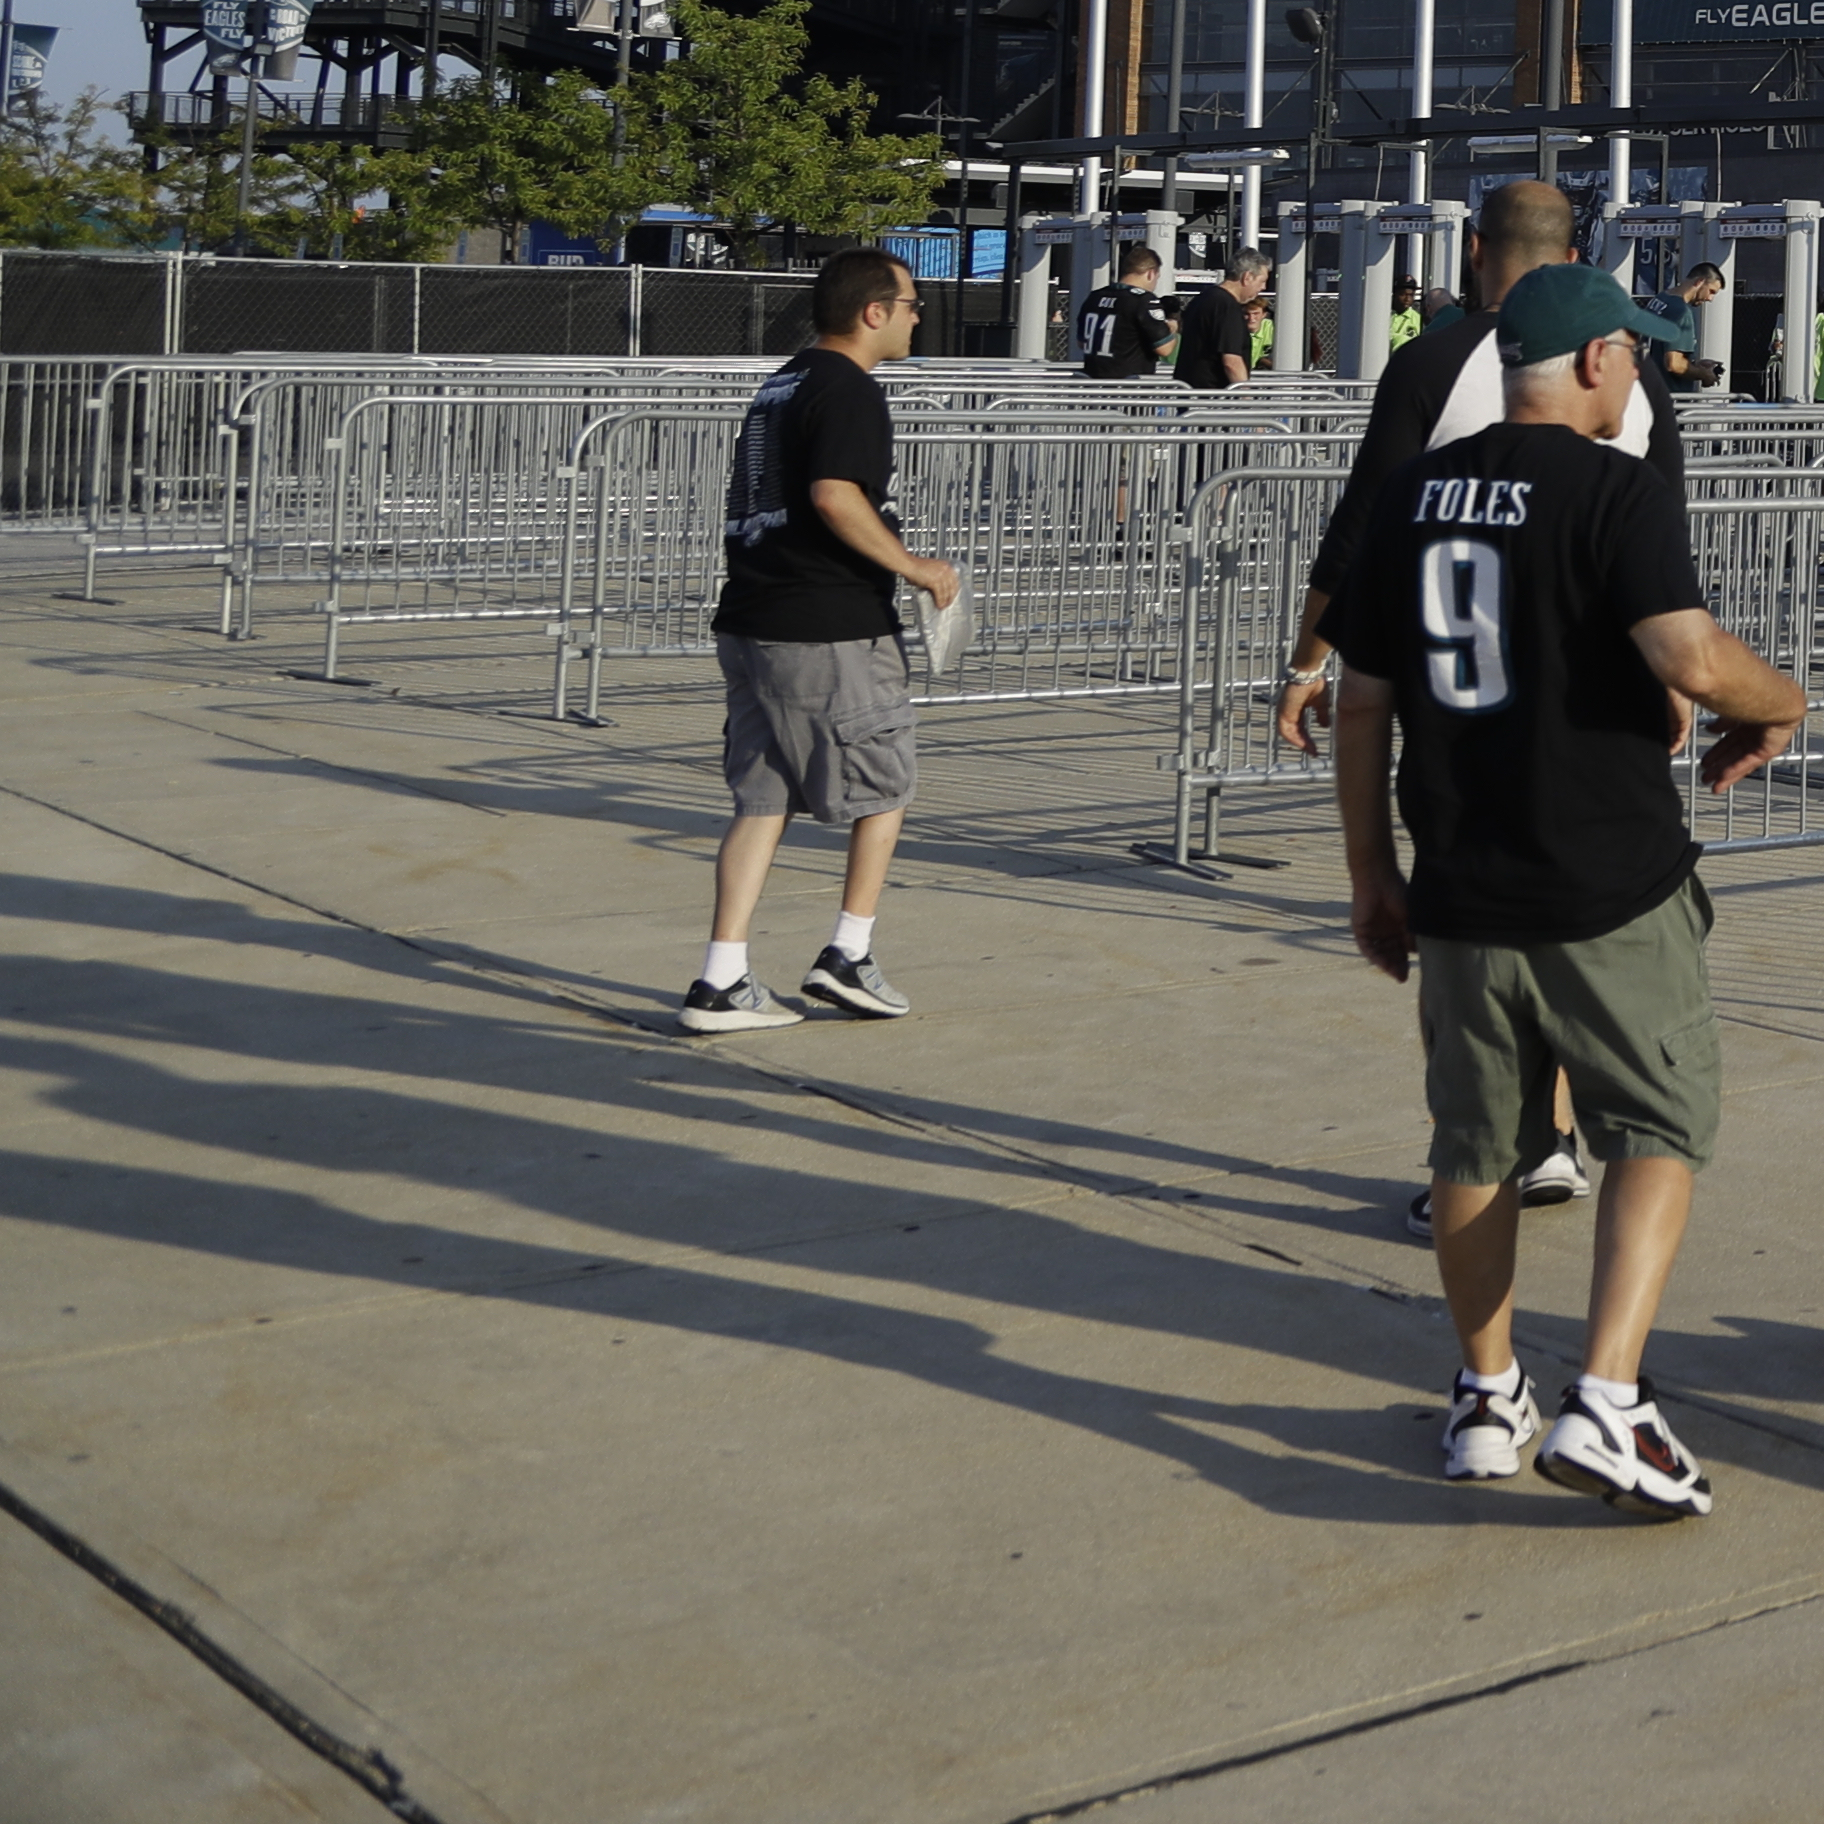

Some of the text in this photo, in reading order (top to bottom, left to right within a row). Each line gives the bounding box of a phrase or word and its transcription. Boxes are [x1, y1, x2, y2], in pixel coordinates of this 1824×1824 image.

[205, 9, 246, 28] EAGLES
[213, 1, 240, 10] FLY
[221, 28, 245, 39] FLY
[1083, 312, 1117, 357] 91
[1413, 478, 1533, 526] FOLES
[1421, 538, 1509, 709] 9
